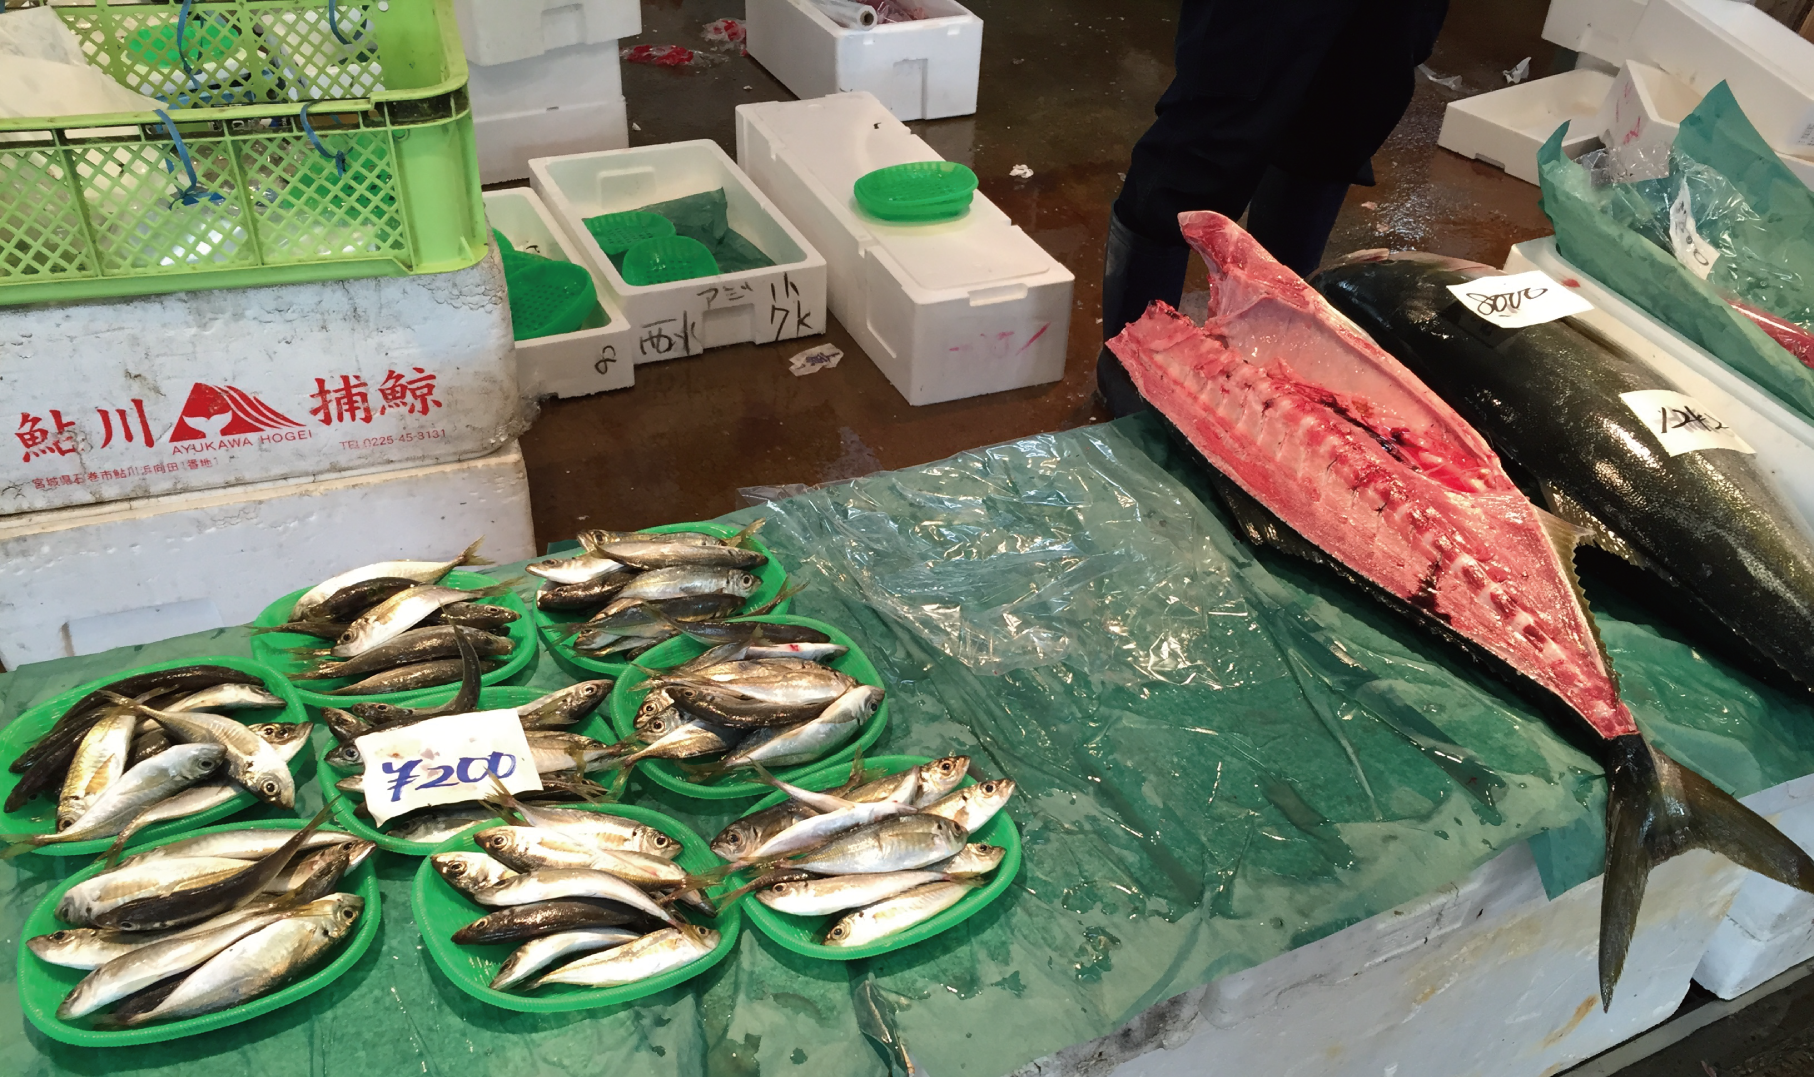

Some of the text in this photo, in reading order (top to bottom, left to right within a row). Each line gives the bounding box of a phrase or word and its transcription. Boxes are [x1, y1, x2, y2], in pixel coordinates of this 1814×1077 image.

[14, 366, 443, 463] 鮎川 捕鯨
[172, 428, 313, 456] AYUKAWA HOGEI
[381, 750, 517, 802] ¥200
